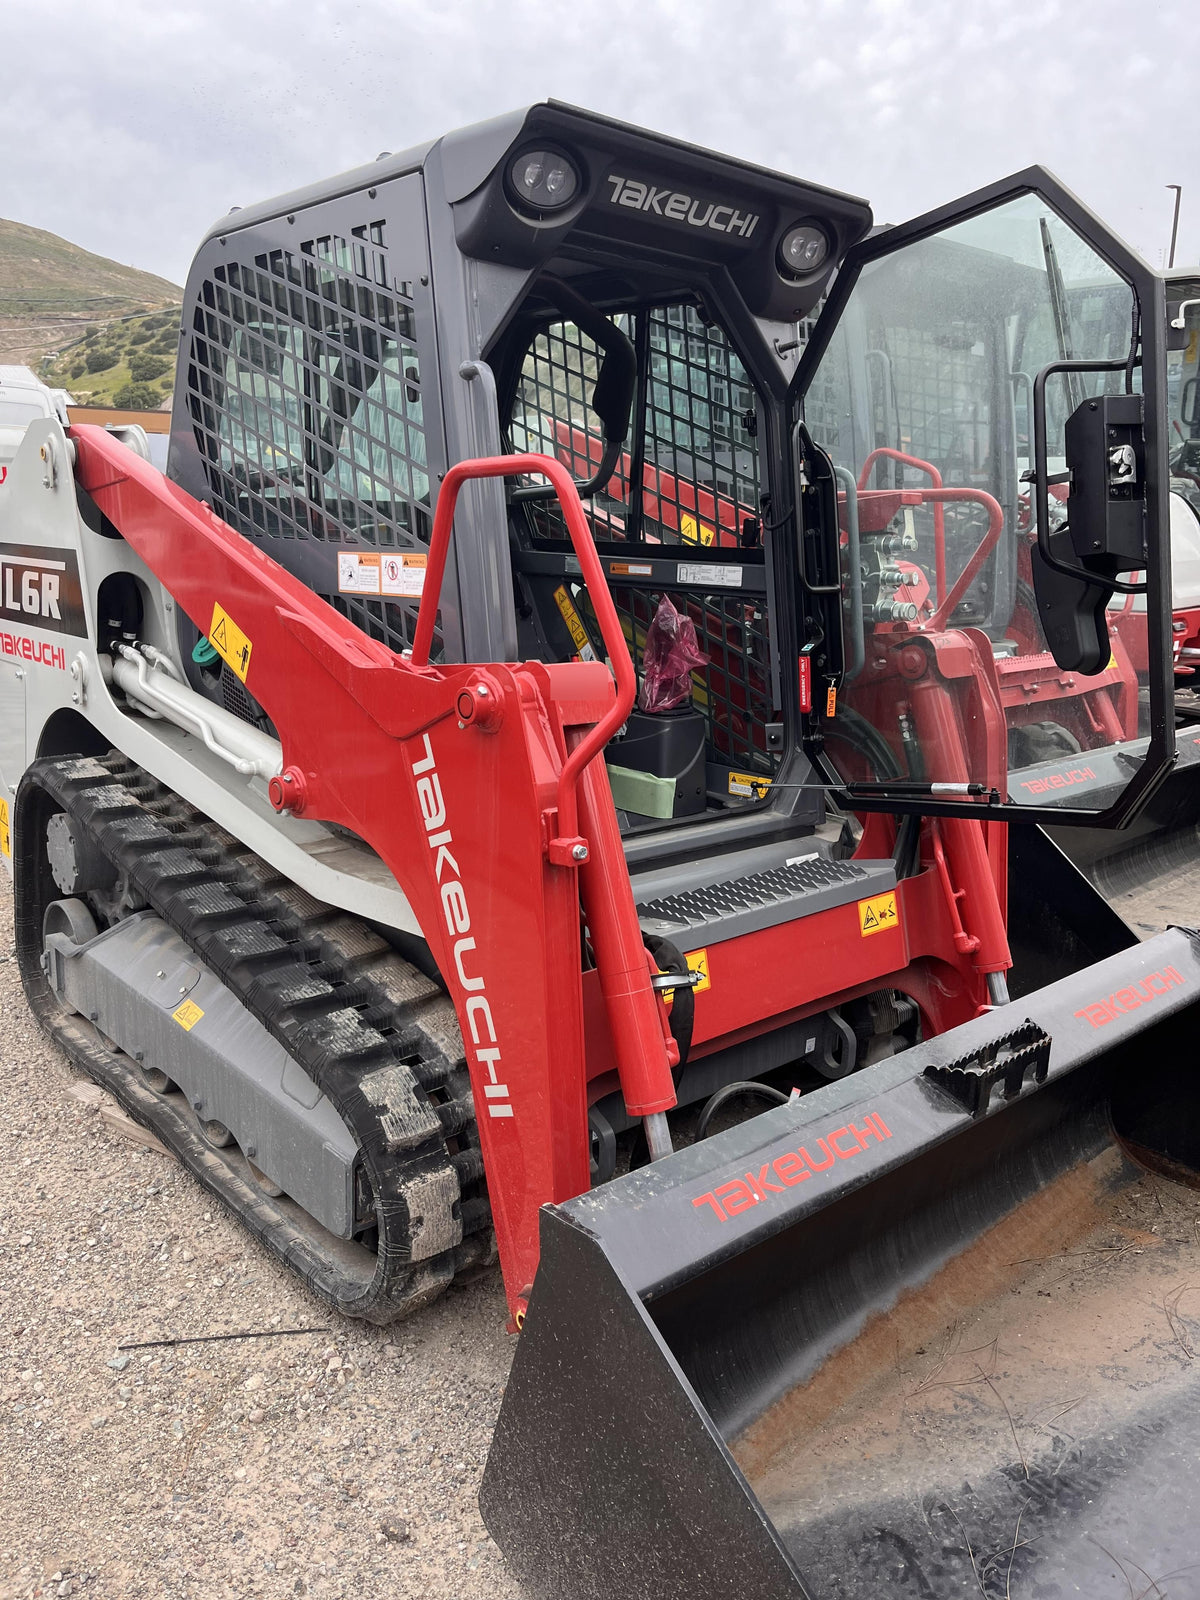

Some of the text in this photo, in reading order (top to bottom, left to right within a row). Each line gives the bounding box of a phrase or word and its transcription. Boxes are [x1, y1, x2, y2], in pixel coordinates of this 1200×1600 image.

[608, 174, 760, 238] TAKEUCHI
[1020, 767, 1096, 795] TAKEUCHI
[409, 733, 513, 1118] TAKEUCHI
[1074, 965, 1186, 1029] TAKEUCHI
[692, 1112, 893, 1223] TAKEUCHI
